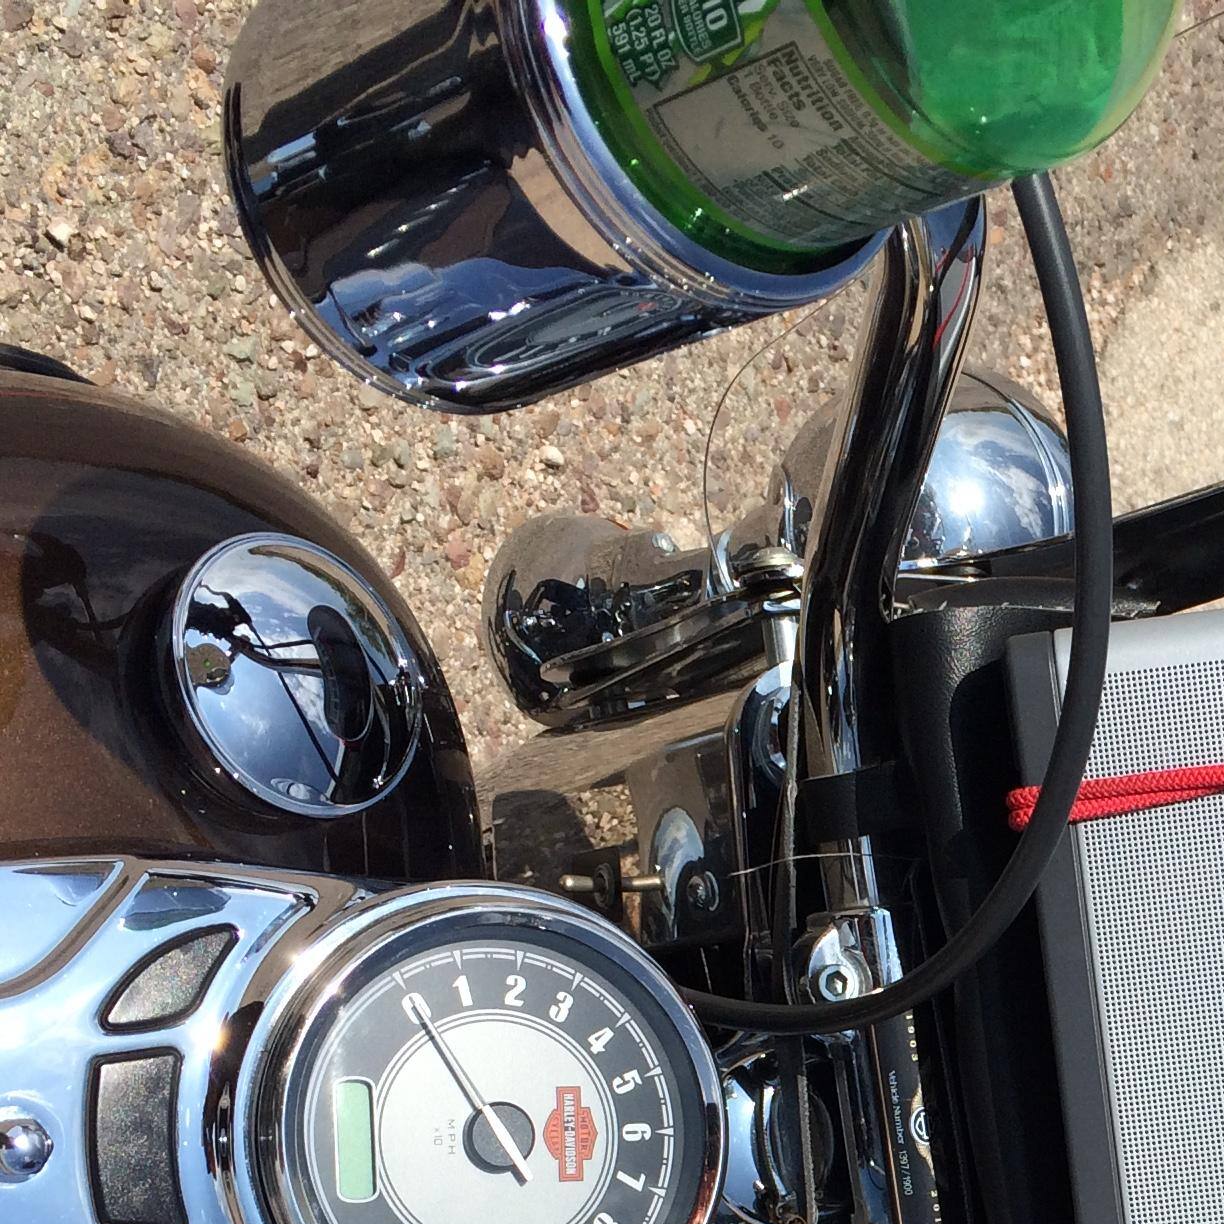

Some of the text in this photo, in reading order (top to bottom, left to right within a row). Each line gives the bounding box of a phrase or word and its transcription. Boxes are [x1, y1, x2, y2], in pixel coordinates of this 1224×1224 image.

[612, 22, 644, 83] 591 mL
[626, 8, 661, 82] (1.25 PT)
[644, 4, 676, 70] 20 FL OZ
[748, 81, 778, 121] Bottle
[766, 56, 807, 111] Facts
[782, 47, 844, 132] Nutrition
[726, 74, 785, 150] Calories 10
[776, 100, 800, 128] Size
[401, 992, 432, 1025] 0
[452, 975, 474, 1008] 1
[504, 974, 527, 1008] 2
[549, 991, 574, 1023] 3
[587, 1027, 615, 1055] 4
[905, 1014, 919, 1062] 1903
[612, 1069, 642, 1095] 5
[888, 1070, 900, 1105] Vehicle
[563, 1093, 577, 1175] HARLEY-DAVIDSON
[579, 1114, 589, 1151] MOTOR
[622, 1122, 652, 1142] 6
[892, 1105, 905, 1144] Number
[616, 1170, 646, 1192] 7
